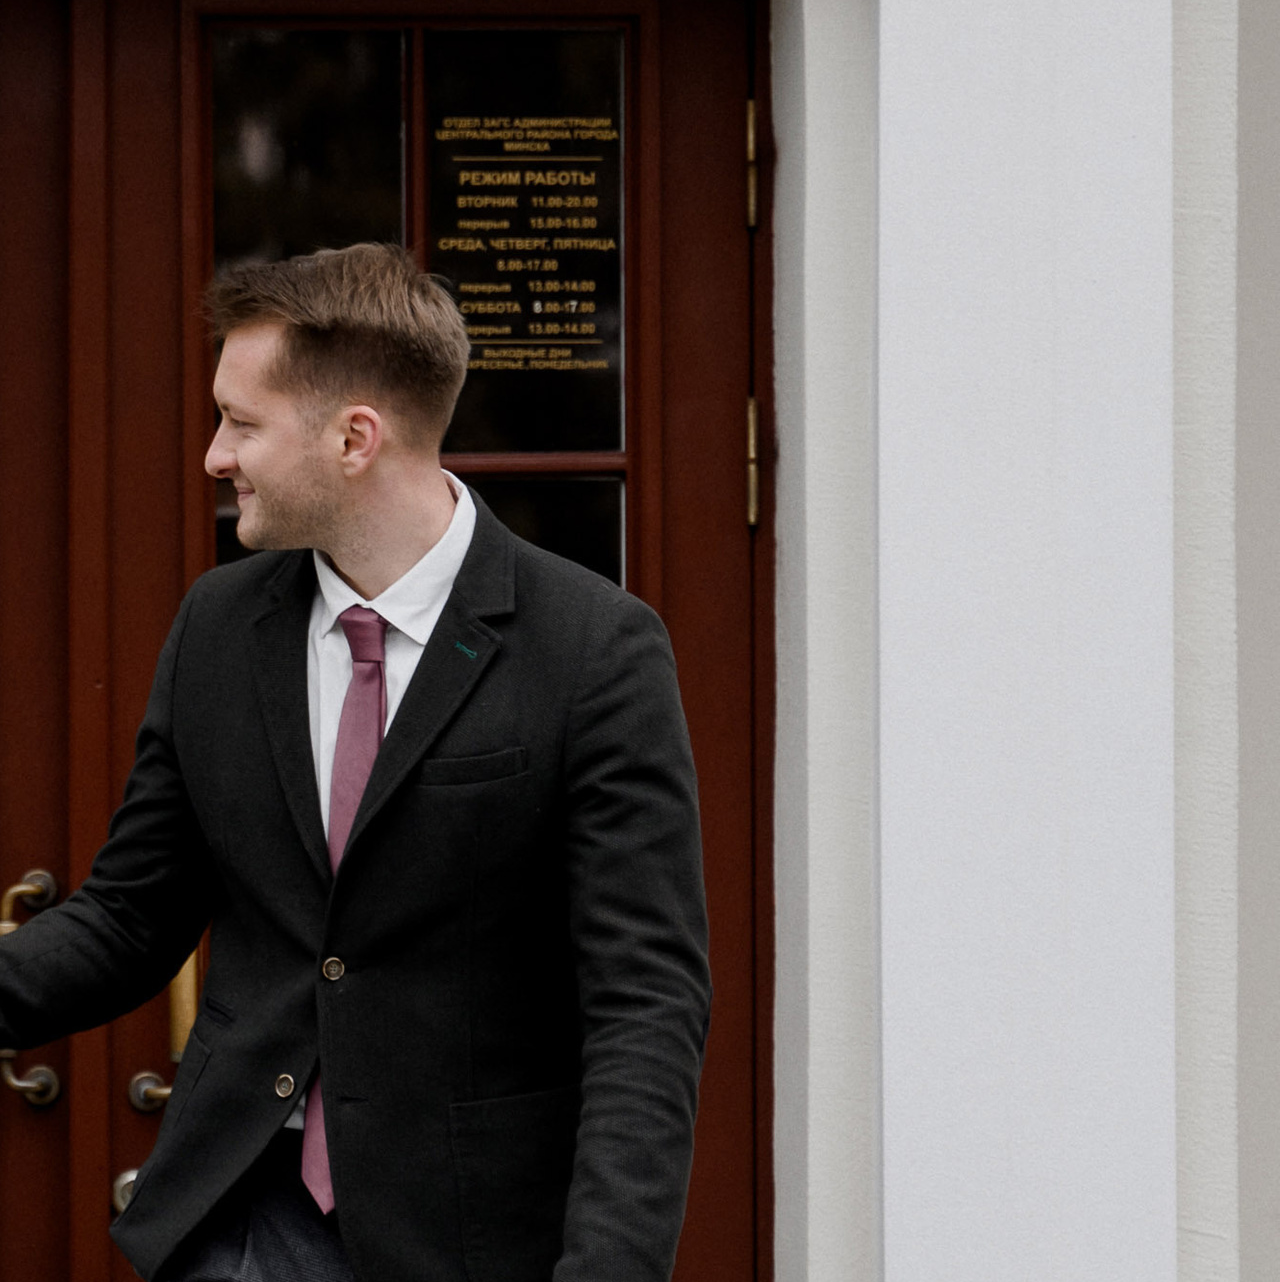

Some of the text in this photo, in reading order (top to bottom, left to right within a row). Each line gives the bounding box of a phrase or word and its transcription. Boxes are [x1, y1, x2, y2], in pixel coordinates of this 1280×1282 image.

[443, 117, 612, 129] ОТДЕЛ ЗАГС АДМИНИСТРАЦИИ
[435, 129, 619, 140] ЦЕНТРАЛЬНОГО РАЙОНА ГОРОДА
[503, 142, 551, 151] МИНСКА
[459, 171, 596, 185] РЕЖИМ РАБОТЫ
[457, 196, 598, 208] ВТОРНИК 11.00-20.00
[439, 238, 616, 252] СРЕДА, ЧЕТВЕРГ, ПЯТНИЦА
[460, 300, 596, 313] СУББОТА 8.00-17.00
[484, 349, 572, 359] ВЫХОДНЫЕ ДНИ
[530, 360, 608, 370] ПОНЕДЕЛЬНИК
